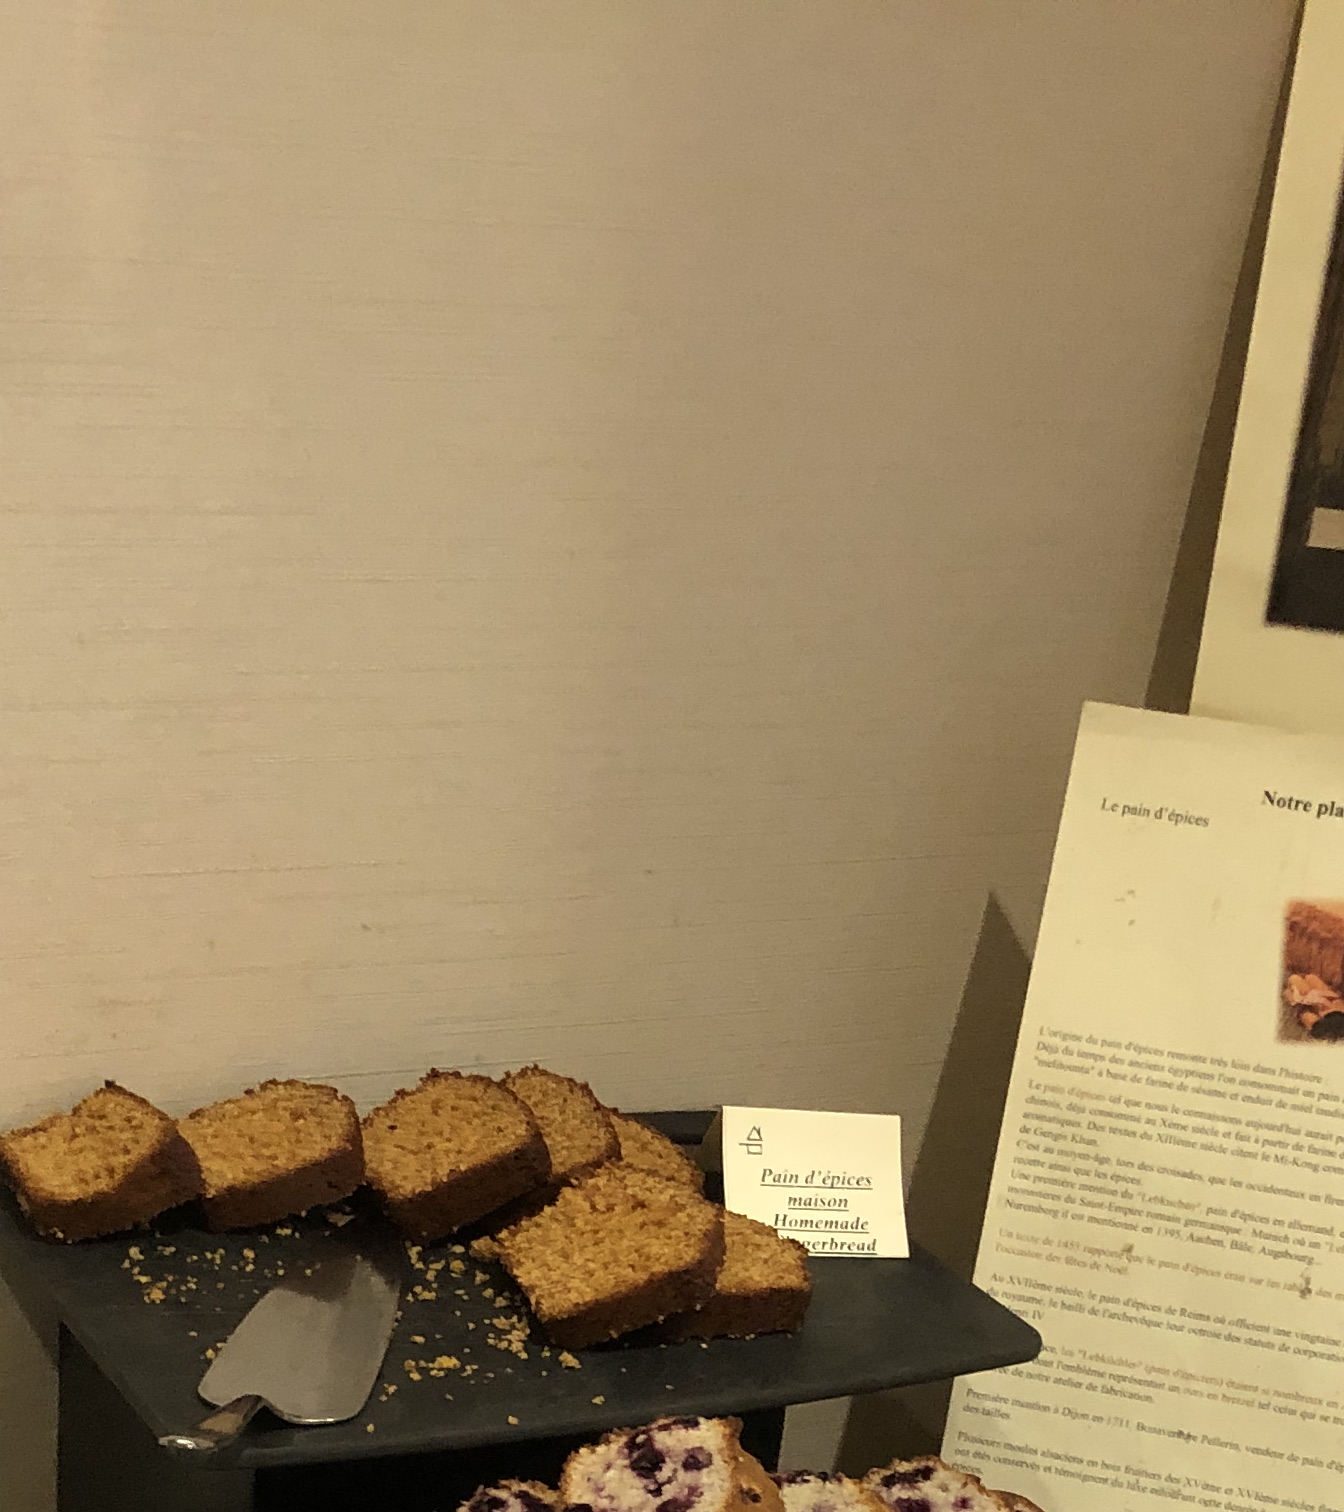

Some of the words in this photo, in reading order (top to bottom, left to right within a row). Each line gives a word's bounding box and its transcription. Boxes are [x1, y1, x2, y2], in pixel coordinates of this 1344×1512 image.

[1262, 790, 1312, 812] Notre
[1101, 797, 1118, 811] Le
[1121, 803, 1150, 818] pain
[1154, 807, 1210, 828] d'épices
[760, 1168, 799, 1184] Pain
[805, 1170, 873, 1188] d'épices
[788, 1194, 849, 1209] maison
[773, 1213, 869, 1231] Homemade
